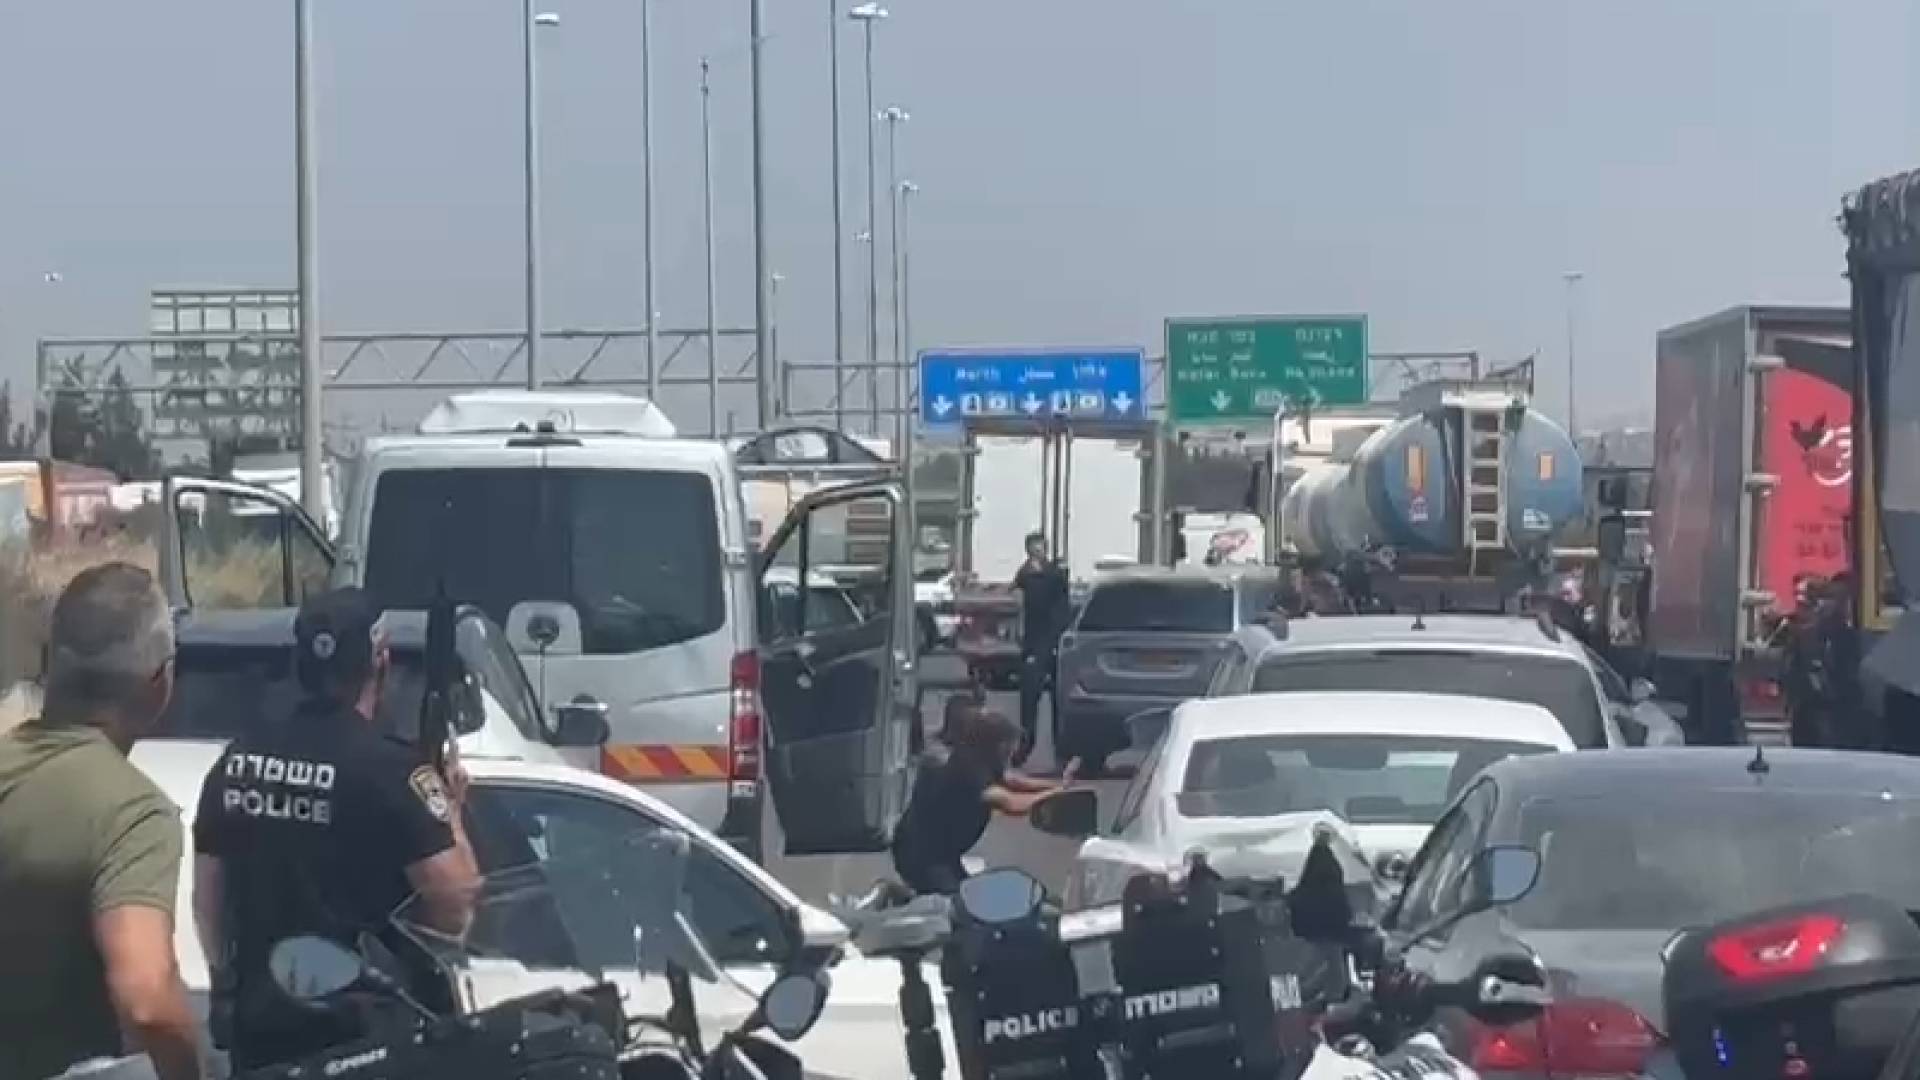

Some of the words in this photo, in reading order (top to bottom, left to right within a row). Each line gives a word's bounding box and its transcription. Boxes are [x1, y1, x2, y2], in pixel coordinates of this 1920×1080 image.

[225, 753, 336, 789] משטרה
[223, 788, 332, 824] POLICE
[983, 1006, 1079, 1045] POLICE
